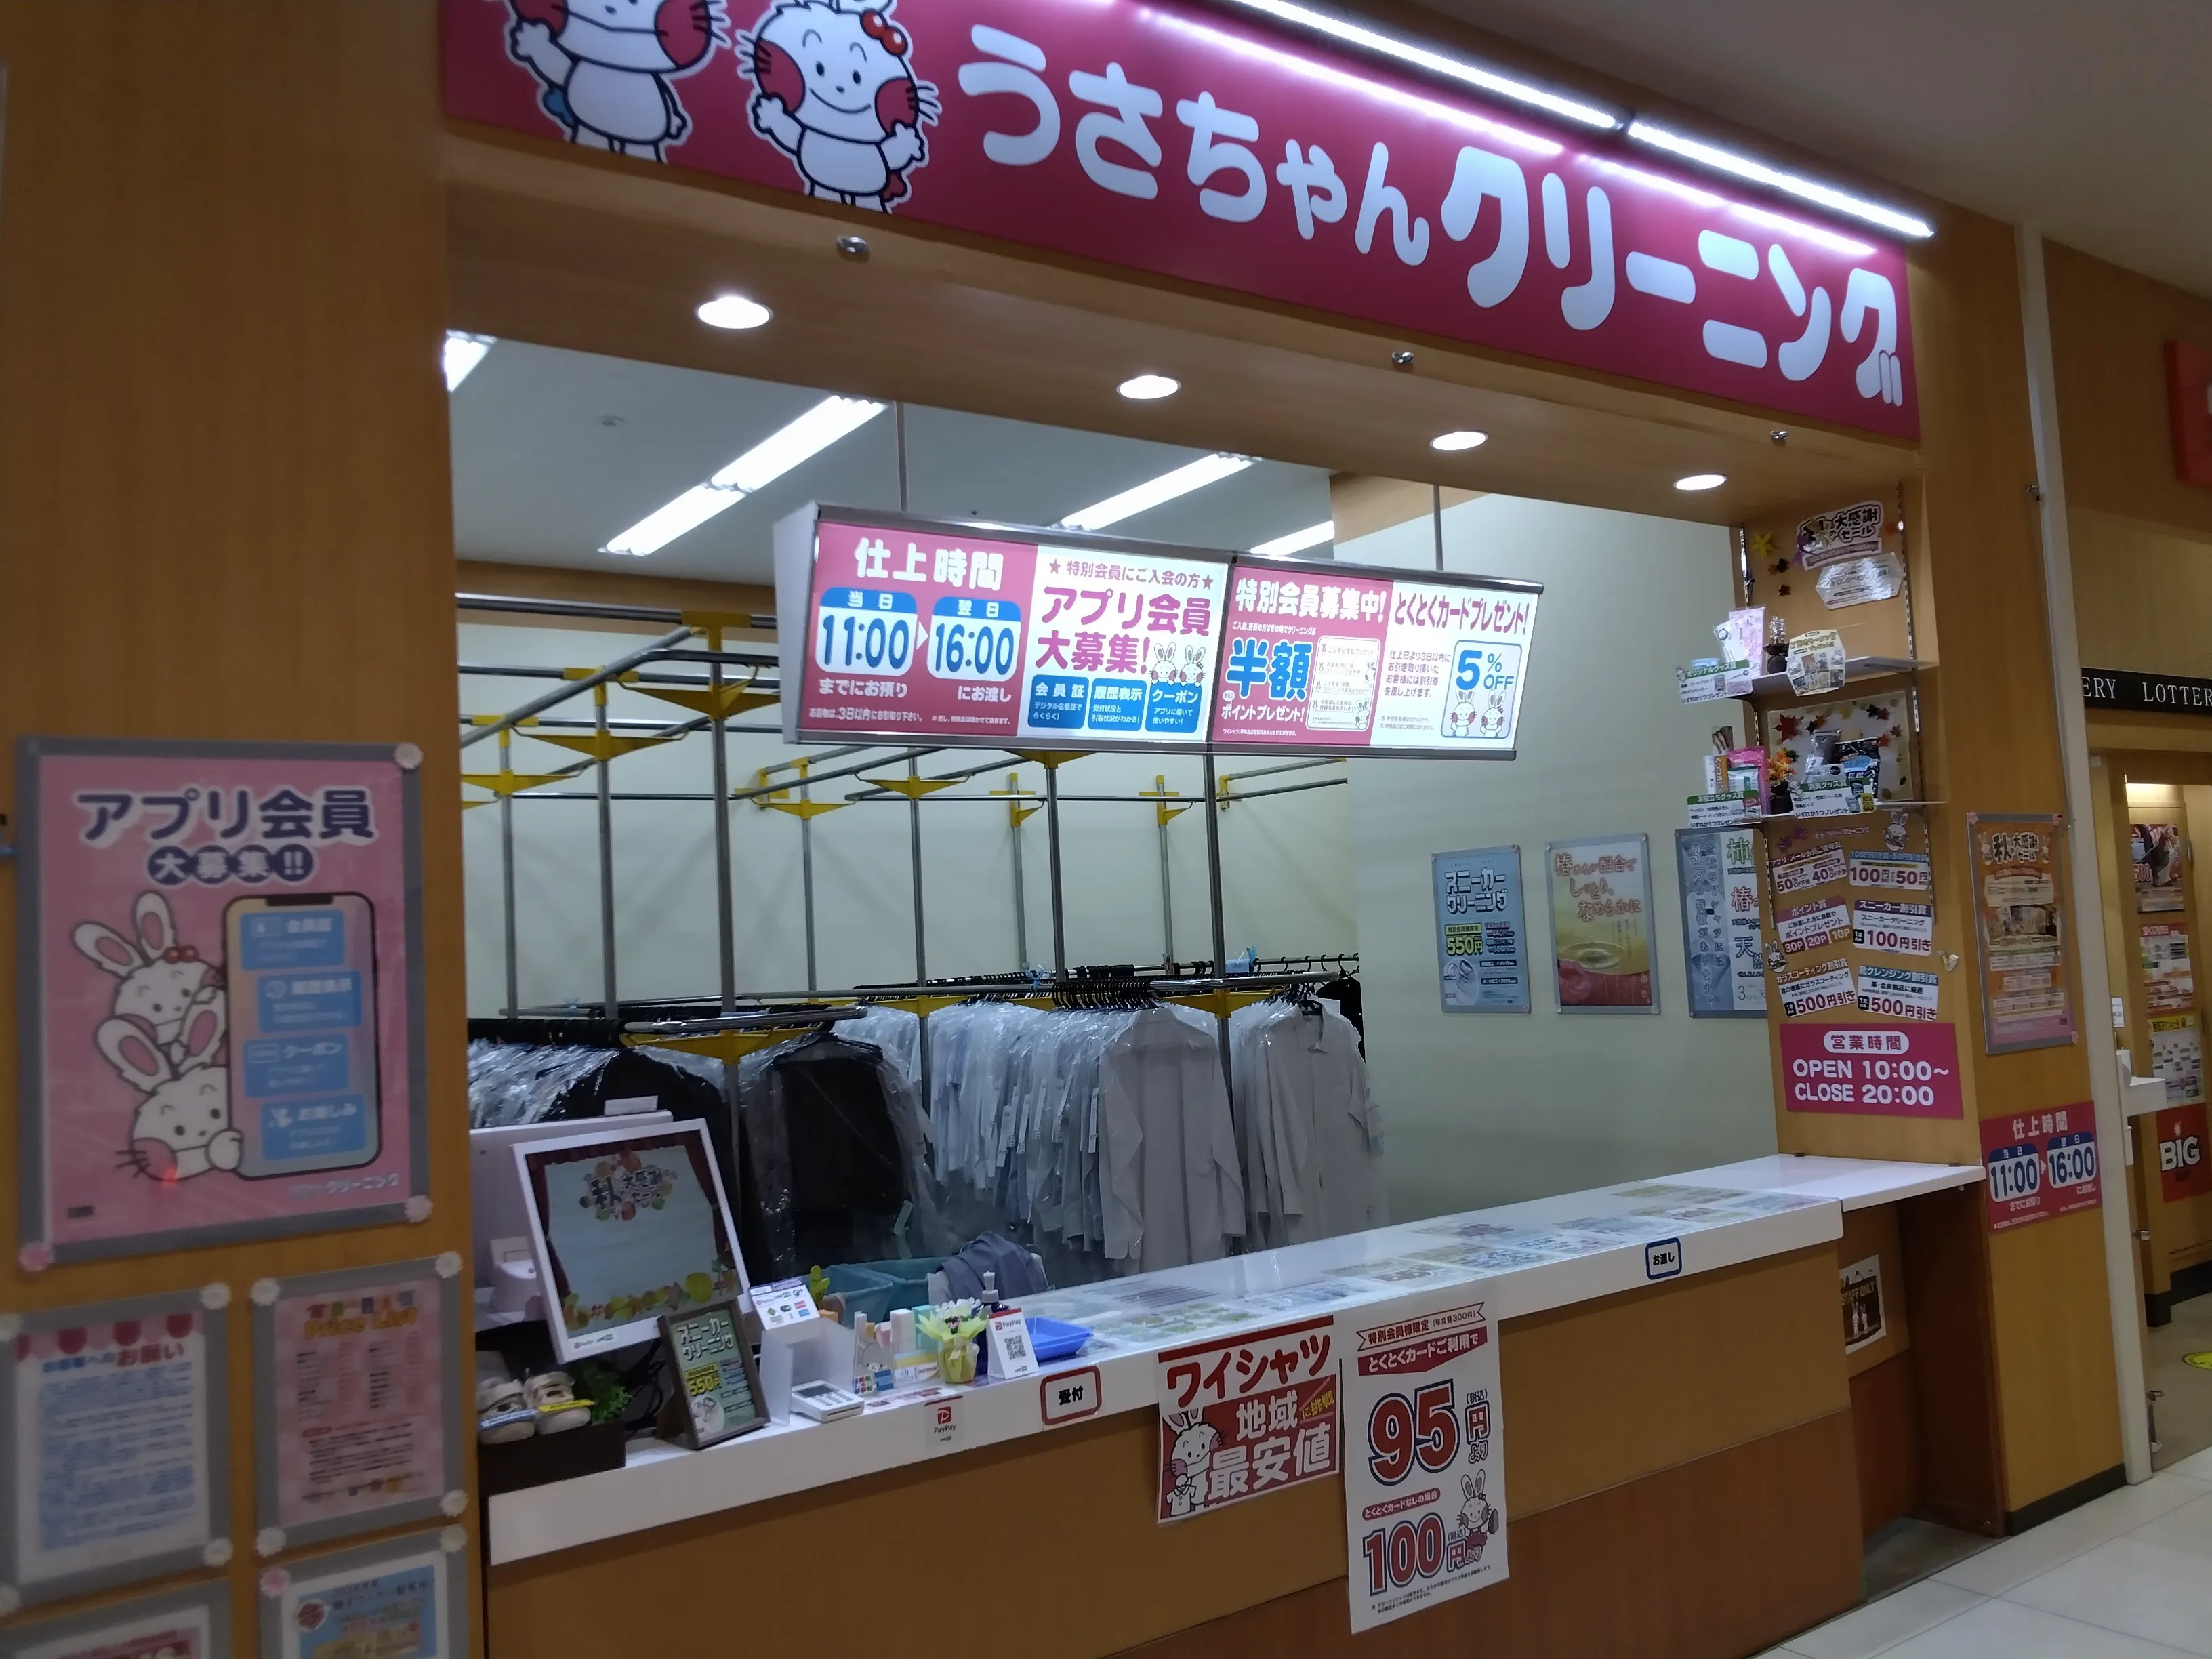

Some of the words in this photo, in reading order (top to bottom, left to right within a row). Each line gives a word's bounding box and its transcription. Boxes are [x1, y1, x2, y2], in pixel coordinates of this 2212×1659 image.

[957, 24, 1904, 407] うさちゃんクリーニング
[855, 537, 1004, 591] 仕上時間
[848, 591, 893, 611] 当日
[957, 600, 1000, 618] 翌日
[1041, 586, 1212, 636] アプリ会員
[1235, 577, 1387, 623] 特別会員募集中!
[1394, 592, 1530, 636] とくとくカードプレゼント!
[823, 614, 909, 670] 11:00
[935, 622, 1014, 676] 16:00
[1035, 630, 1150, 674] 大募集!
[1225, 637, 1314, 702] 半額
[819, 678, 907, 698] までにお預り
[958, 685, 1012, 703] にお渡し
[1035, 682, 1084, 699] 会員証
[1094, 685, 1143, 701] 履歴表示
[1483, 674, 1515, 691] OFF
[1152, 688, 1199, 704] クーポン
[1221, 704, 1305, 722] ポイントプレゼント!
[76, 787, 376, 840] アプリ会員
[1727, 838, 1755, 865] 柿
[1444, 867, 1506, 894] スニーカー
[1850, 867, 1880, 882] 100
[1896, 870, 1918, 884] 50
[1446, 888, 1508, 914] クリーニング
[1578, 899, 1641, 922] なめらかに
[1791, 899, 1828, 916] ポイント賞
[1785, 918, 1843, 939] ポイントプレゼント
[1861, 914, 1925, 926] スニーカークリーニング
[1446, 935, 1483, 956] 550円
[1784, 941, 1803, 953] 30P
[1807, 935, 1826, 947] 20P
[1832, 928, 1851, 940] 10P
[1867, 930, 1931, 951] 100円引き
[1796, 990, 1856, 1014] 500円引き
[1871, 997, 1937, 1020] 500円引き
[1831, 1034, 1902, 1050] 営業時間
[1793, 1059, 1853, 1079] OPEN
[1795, 1082, 1855, 1103] CLOSE
[1862, 1084, 1934, 1106] 20:00
[2013, 1111, 2068, 1140] 仕上時間
[2159, 1136, 2201, 1172] BIG
[1991, 1158, 2038, 1198] 11:00
[2049, 1146, 2095, 1185] 16:00
[1652, 1252, 1675, 1266] お渡し
[1368, 1320, 1429, 1345] 特別会員様限定
[1368, 1333, 1479, 1373] とくとくカードご利用で
[1167, 1334, 1330, 1408] ワイシャツ
[1059, 1386, 1084, 1405] 受付
[1236, 1389, 1298, 1441] 地域
[934, 1423, 956, 1434] PayPay
[1368, 1378, 1460, 1486] 95
[1207, 1422, 1330, 1501] 最安値
[1363, 1512, 1445, 1597] 100
